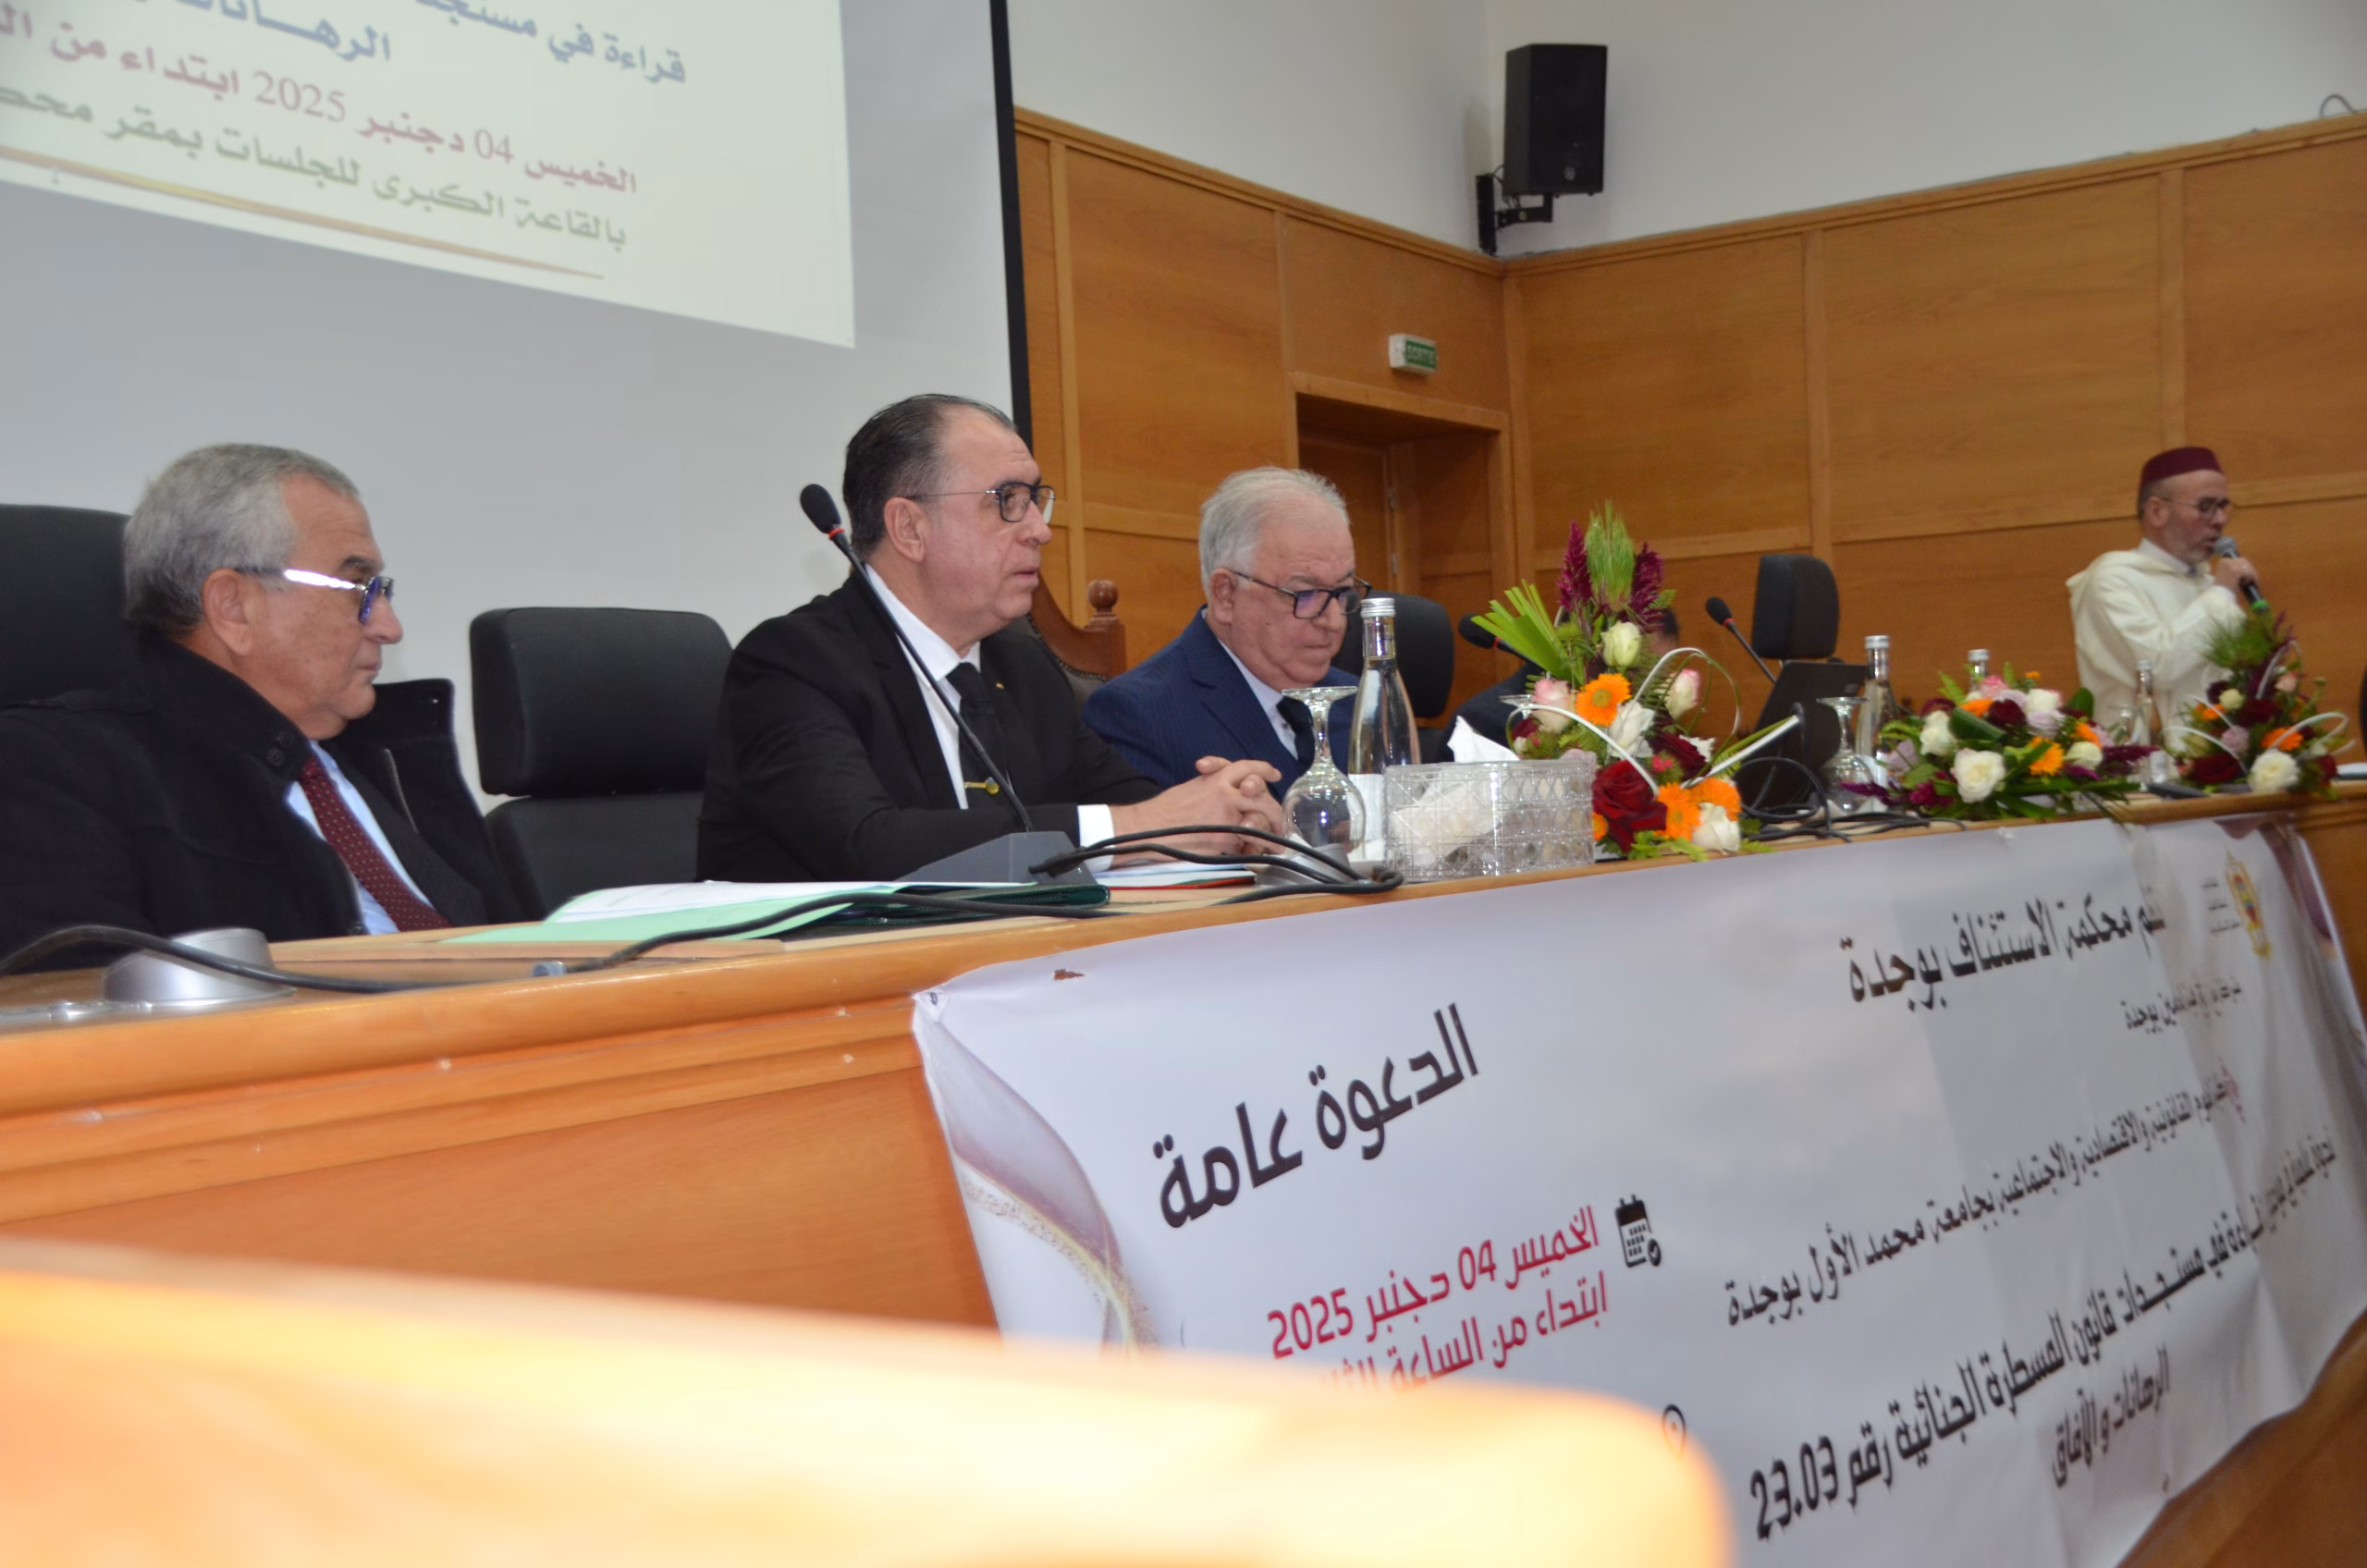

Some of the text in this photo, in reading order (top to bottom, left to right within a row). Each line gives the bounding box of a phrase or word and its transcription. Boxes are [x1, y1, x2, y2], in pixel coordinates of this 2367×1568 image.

[51, 20, 107, 62] من
[548, 23, 595, 64] في
[603, 31, 686, 83] قراءة
[120, 45, 239, 102] ابتداء
[252, 70, 346, 123] 2025
[102, 104, 203, 160] بمقر
[215, 127, 361, 190] للجلسات
[353, 112, 464, 154] دجنبر
[474, 129, 514, 164] 04
[373, 176, 505, 217] الكبرى
[524, 160, 637, 194] الخميس
[515, 197, 626, 253] بالقاعة
[1945, 896, 2060, 978] الاستئناف
[2056, 892, 2132, 961] محكمة
[1839, 936, 1947, 1012] بوجدة
[1151, 1002, 1479, 1230] الدعوة عامة
[1864, 1218, 1926, 1266] محمد
[1926, 1183, 1998, 1243] بجامعة
[1267, 1205, 1600, 1360] الخميس 04 دجنبر 2025
[1808, 1222, 1861, 1304] الأول
[1536, 1270, 1608, 1336] ابتداء
[1725, 1270, 1804, 1327] بوجدة
[2071, 1287, 2118, 1366] قانون
[1387, 1316, 1484, 1392] الساعة
[1491, 1316, 1528, 1369] من
[1980, 1308, 2074, 1418] المسطرة
[1889, 1353, 1988, 1470] الجنائية
[1750, 1433, 1838, 1542] 23.03
[1847, 1419, 1893, 1512] رقم
